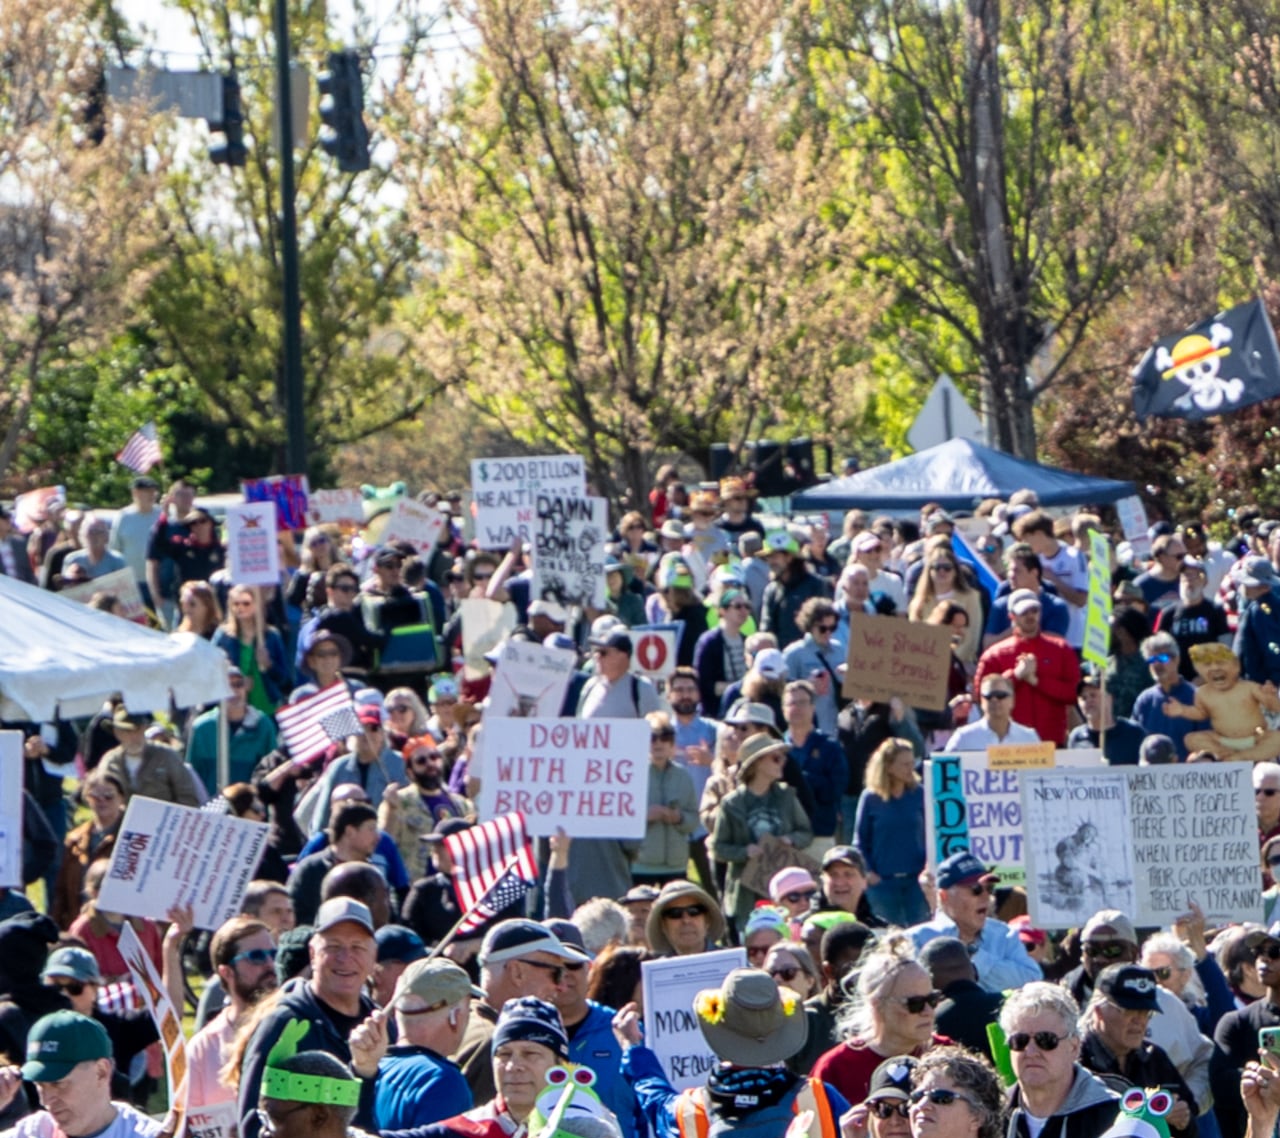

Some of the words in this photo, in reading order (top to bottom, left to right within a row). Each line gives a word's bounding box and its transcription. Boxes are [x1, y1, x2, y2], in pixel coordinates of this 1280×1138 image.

[530, 724, 611, 749] DOWN
[497, 757, 564, 783] WITH
[585, 759, 634, 784] BIG
[1128, 774, 1157, 792] WHEN
[1162, 769, 1243, 790] GOVERNMENT
[494, 790, 636, 817] BROTHER
[1034, 787, 1066, 801] NEW
[1067, 786, 1122, 801] YORKER
[1130, 795, 1164, 815] FEARS
[1167, 796, 1187, 814] ITS
[1194, 792, 1241, 813] PEOPLE
[1131, 818, 1167, 839] THERE
[1173, 817, 1189, 838] IS
[243, 825, 267, 867] Trump
[1135, 845, 1170, 863] WHEN
[1174, 843, 1218, 862] PEOPLE
[1222, 841, 1252, 861] FEAR
[231, 867, 251, 904] wants
[1148, 868, 1176, 887] THEIR
[1179, 864, 1262, 886] GOVERNMENT
[1150, 890, 1182, 911] THERE
[655, 1008, 697, 1039] MON
